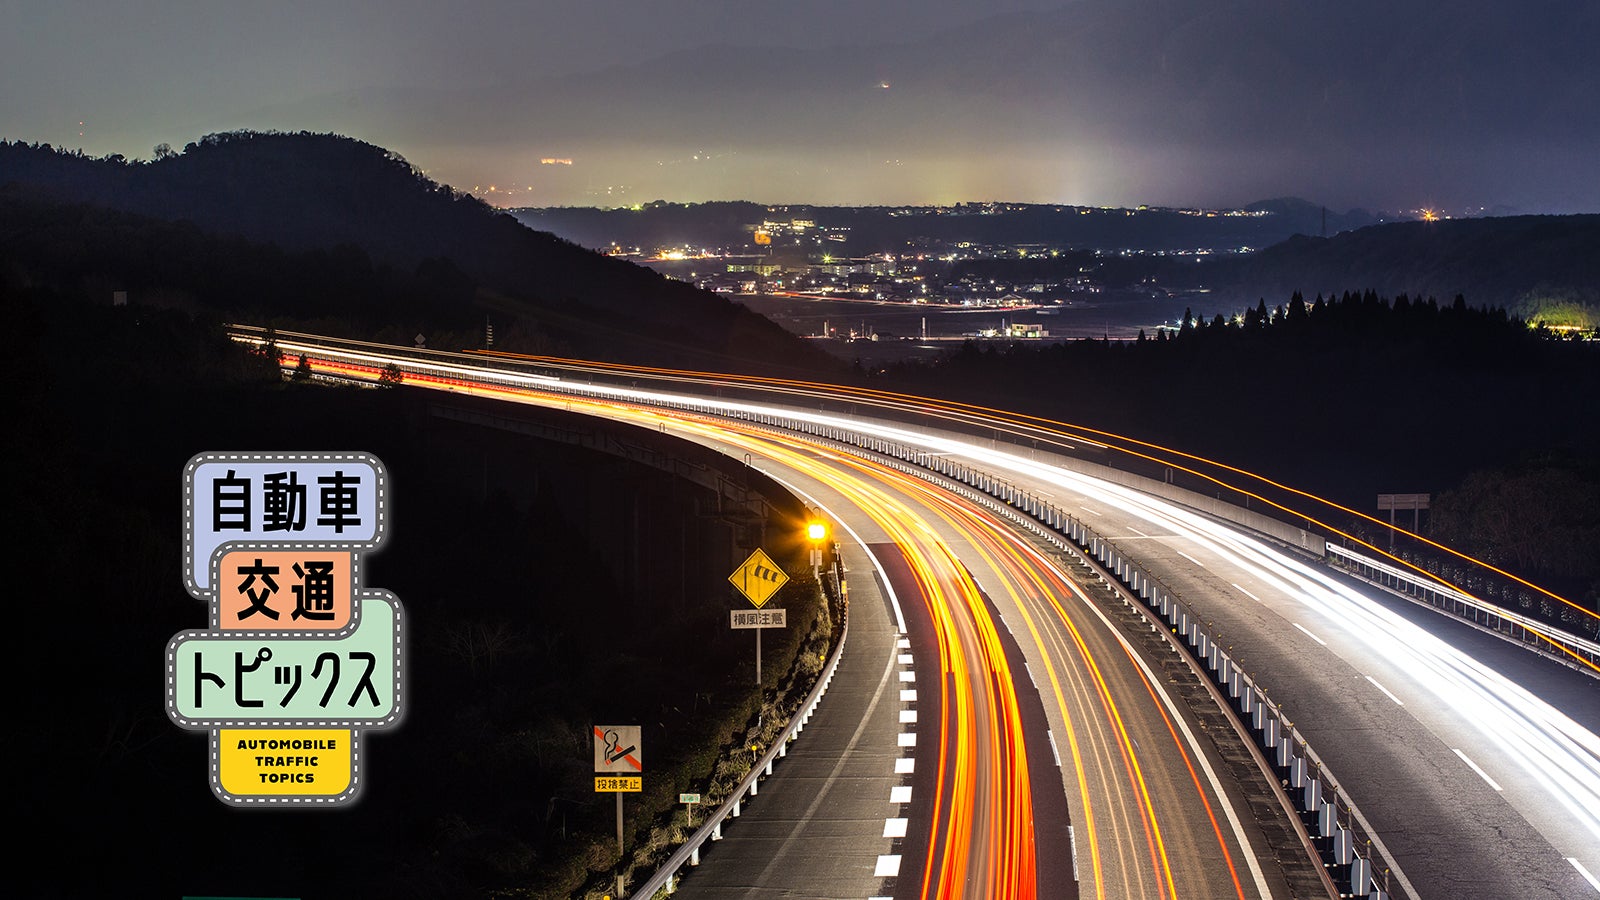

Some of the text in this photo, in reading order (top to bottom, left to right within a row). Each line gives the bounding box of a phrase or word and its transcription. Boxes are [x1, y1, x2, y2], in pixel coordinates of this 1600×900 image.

[733, 612, 783, 626] 横風注意
[597, 779, 640, 790] 投捨禁止
